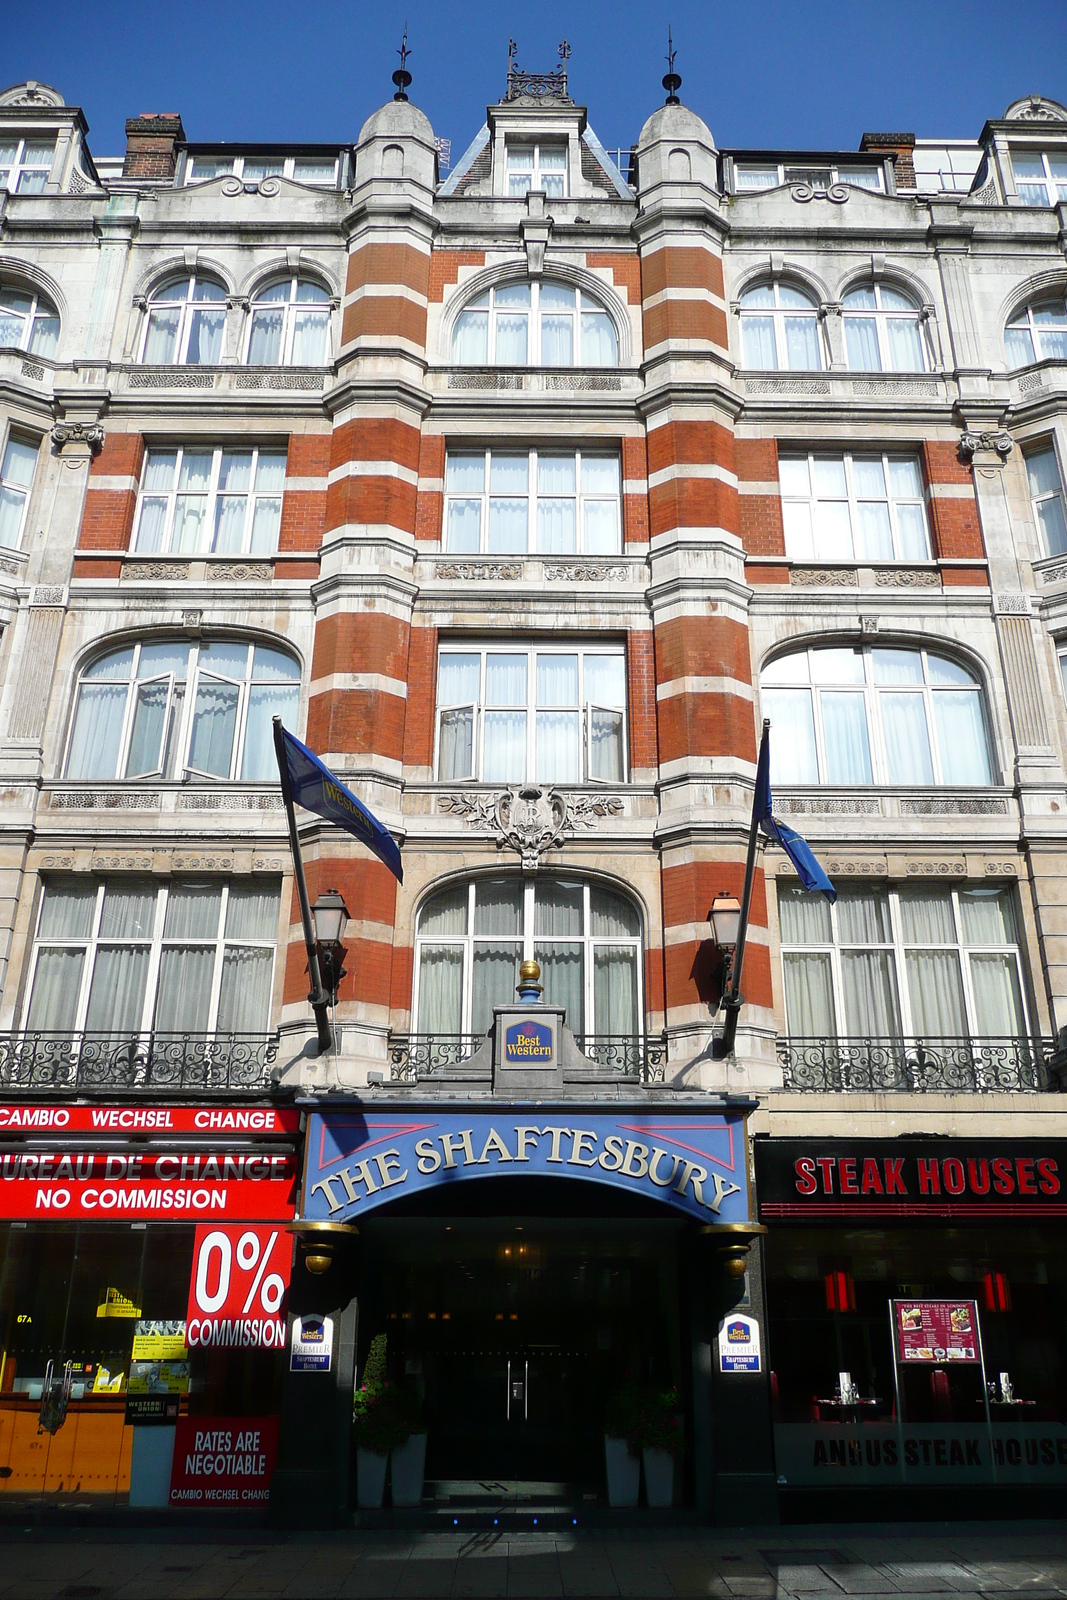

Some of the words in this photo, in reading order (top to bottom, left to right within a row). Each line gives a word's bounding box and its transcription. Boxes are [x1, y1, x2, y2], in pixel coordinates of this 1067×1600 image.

[507, 1043, 552, 1056] Western
[517, 1034, 541, 1047] Best
[0, 1109, 70, 1126] CAMBIO
[92, 1110, 173, 1128] WECHSEL
[194, 1111, 275, 1128] CHANGE
[0, 1154, 95, 1181] UREAU
[104, 1154, 143, 1181] DE
[154, 1154, 286, 1181] CHANGE
[311, 1148, 408, 1215] THE
[415, 1125, 742, 1214] SHAFTESBURY
[794, 1157, 908, 1195] STEAK
[916, 1157, 1061, 1195] HOUSES
[35, 1188, 71, 1209] NO
[80, 1188, 227, 1209] COMMISSION
[195, 1230, 285, 1314] 0%
[17, 1315, 32, 1323] 67A
[188, 1318, 286, 1347] COMMISSION
[292, 1344, 330, 1354] PREMIER
[721, 1345, 758, 1354] PREMIER
[194, 1431, 232, 1452] RATES
[234, 1431, 261, 1452] ARE
[812, 1439, 898, 1467] ANGUS
[904, 1439, 982, 1466] STEAK
[185, 1454, 266, 1475] NEGOTIABLE
[171, 1489, 203, 1500] CAMBIO
[205, 1489, 240, 1500] WECHSEL
[241, 1489, 270, 1500] CHANG
